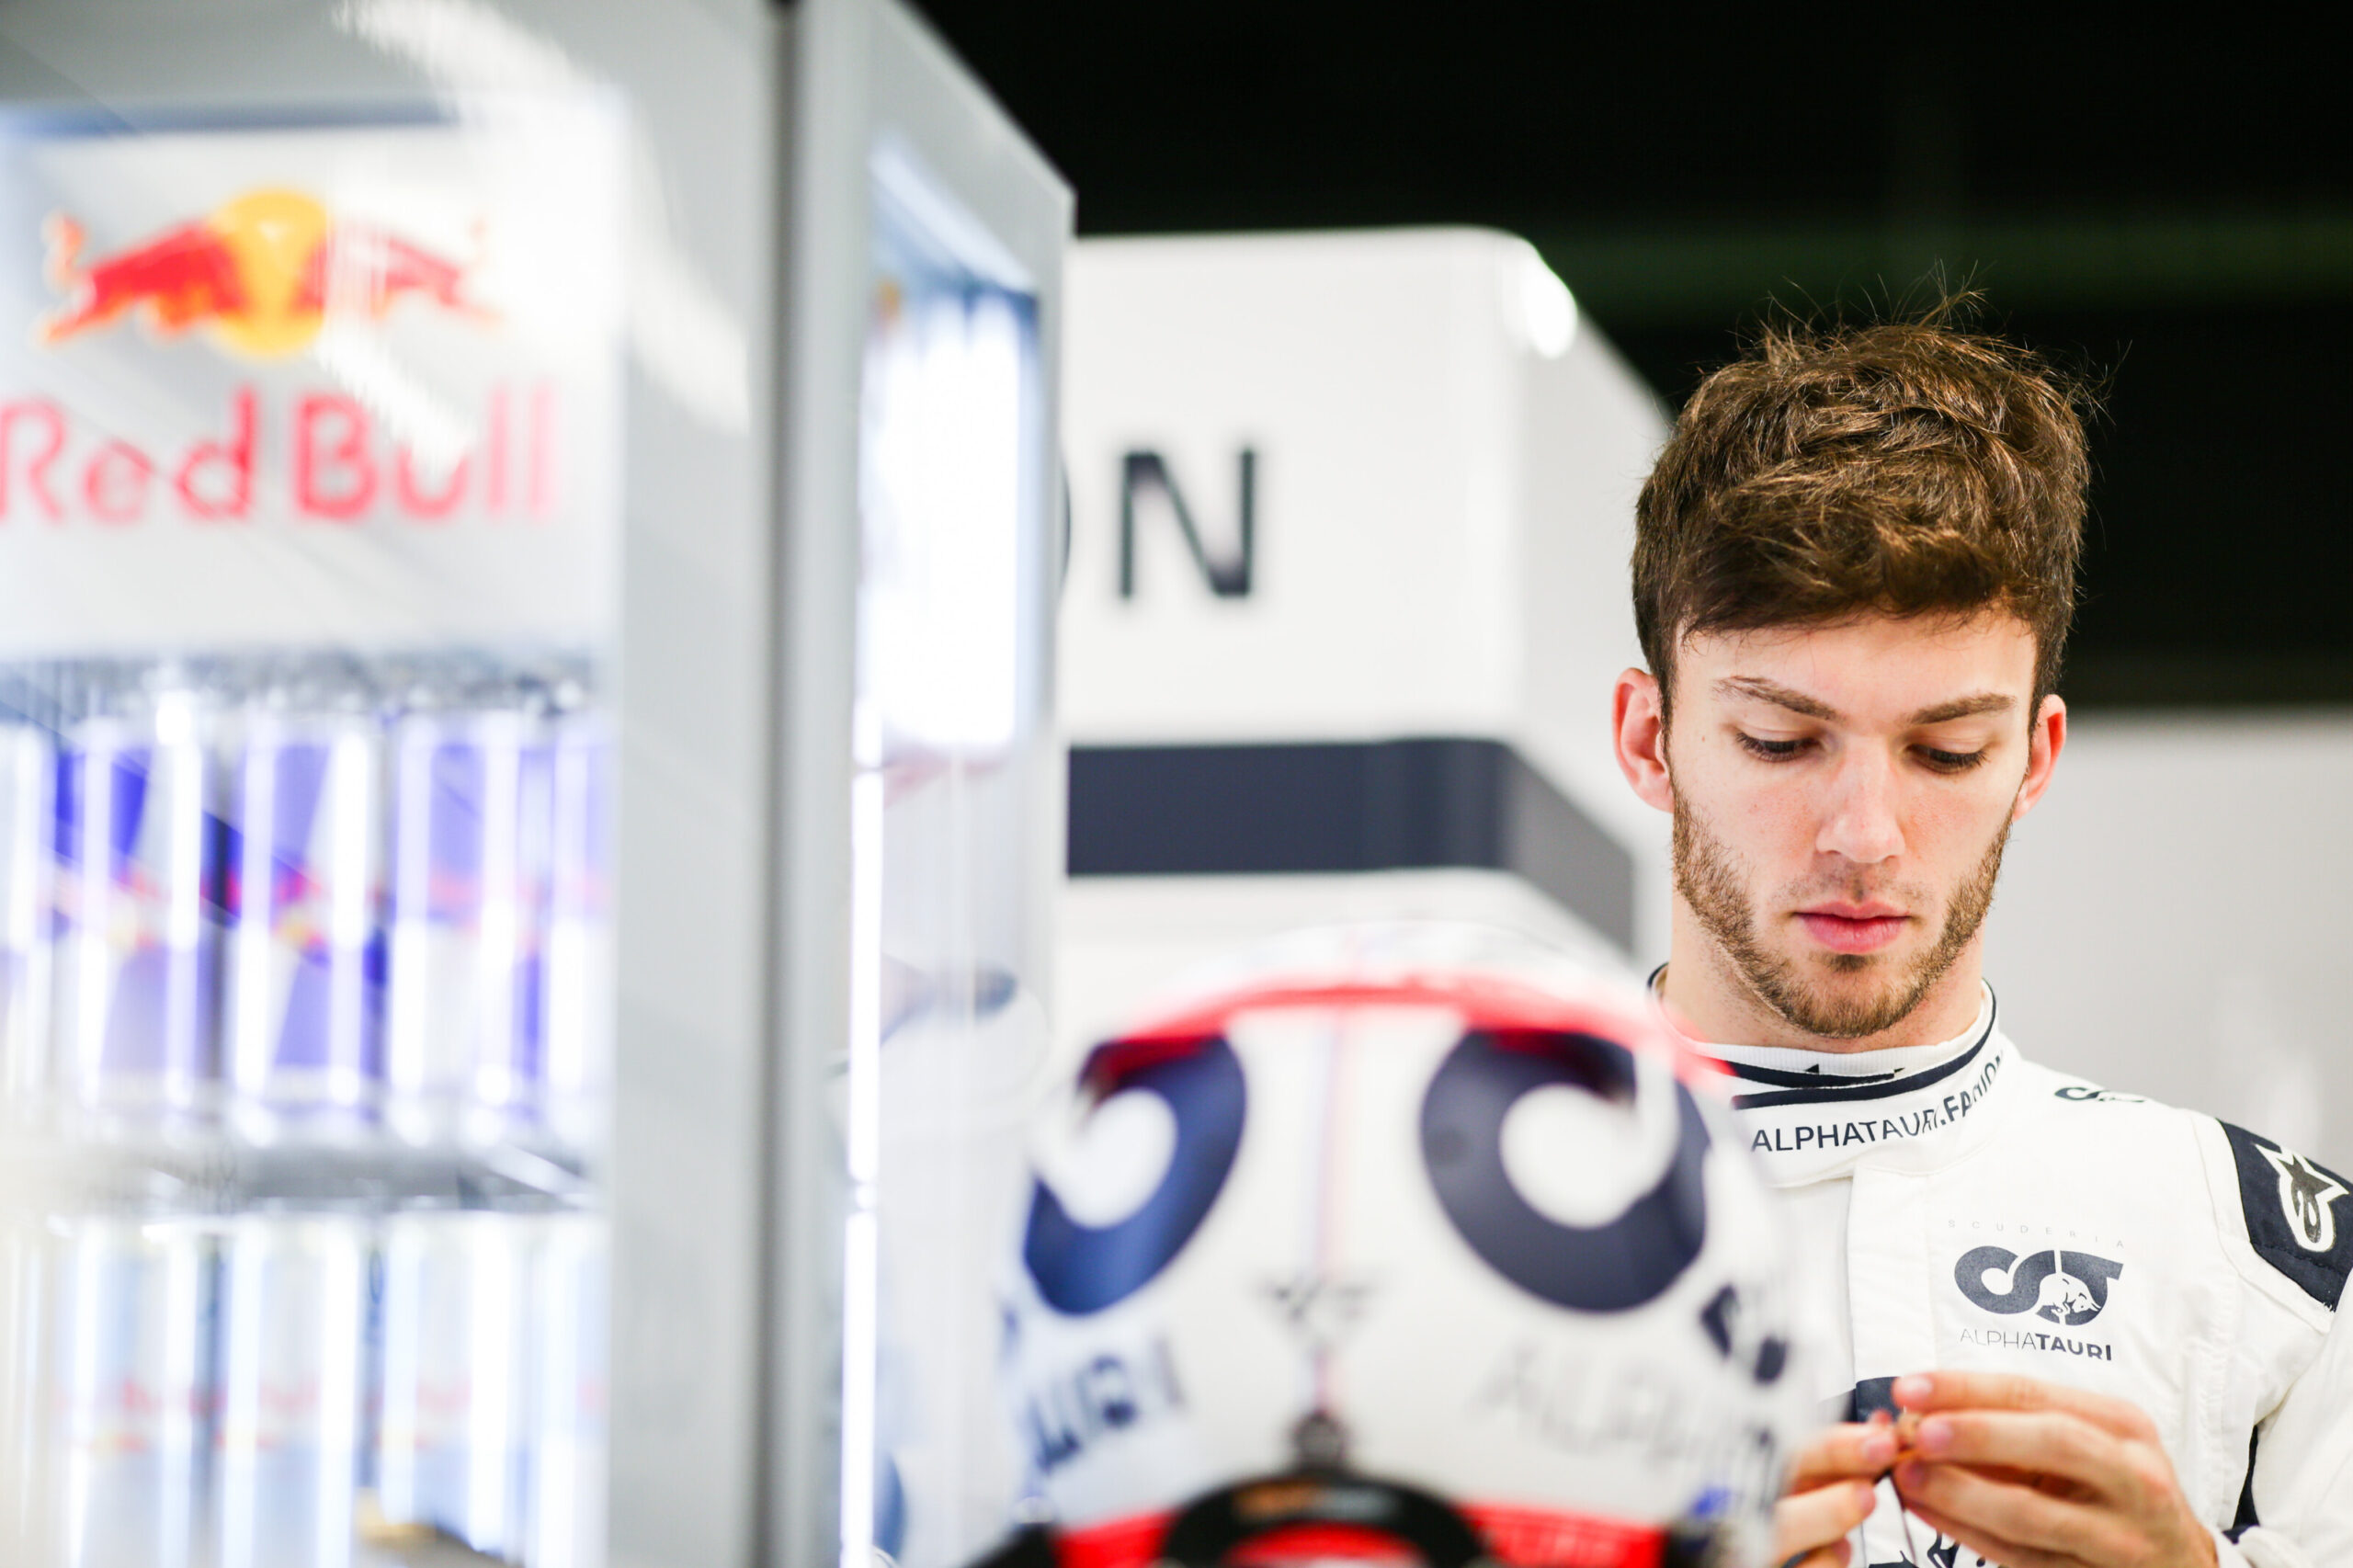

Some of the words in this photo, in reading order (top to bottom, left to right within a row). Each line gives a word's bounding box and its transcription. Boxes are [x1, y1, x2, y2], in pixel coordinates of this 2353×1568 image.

[0, 384, 257, 524] Red
[292, 381, 561, 524] Bull
[1059, 448, 1256, 600] N
[1948, 1219, 2124, 1248] SCUDERIA
[1960, 1328, 2112, 1361] ALPHATAURI
